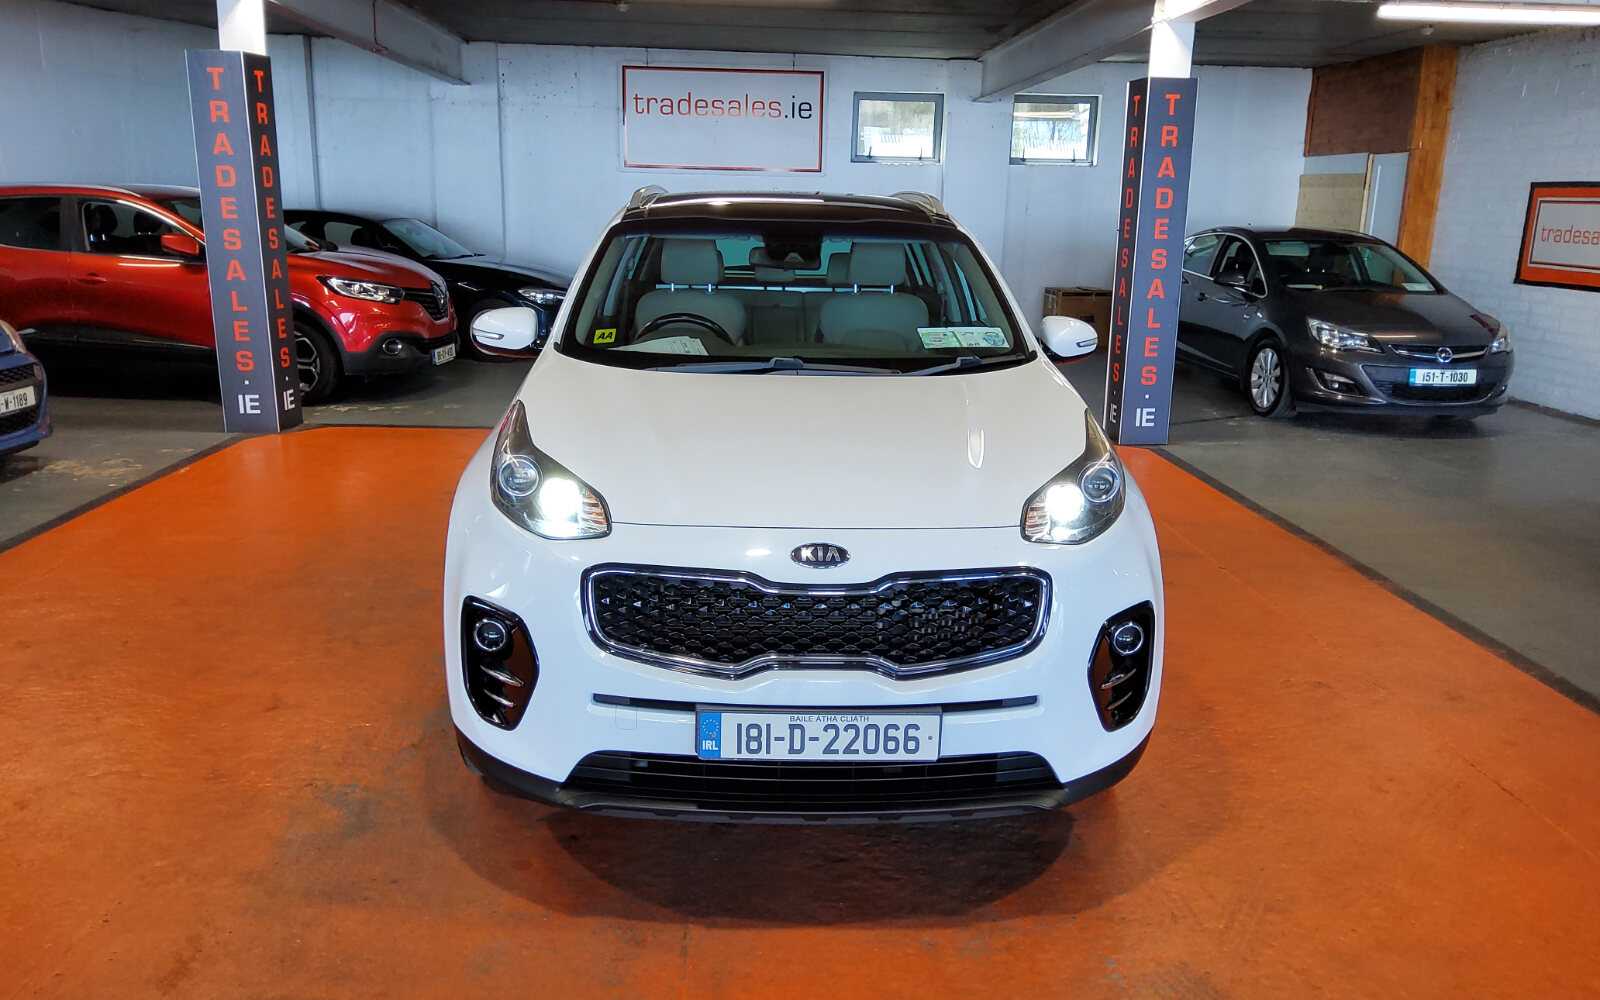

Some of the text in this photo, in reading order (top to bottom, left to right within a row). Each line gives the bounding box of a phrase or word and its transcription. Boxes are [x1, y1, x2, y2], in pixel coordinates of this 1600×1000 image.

[633, 91, 813, 119] tradesales.ie
[1540, 224, 1600, 246] tradesa
[596, 331, 614, 340] AA
[1422, 371, 1469, 383] 151-T-1030
[800, 546, 841, 562] KIA
[789, 715, 870, 723] BAILE ATHA CLIATH
[702, 739, 719, 751] IRL
[736, 723, 921, 755] 181-D-22066
